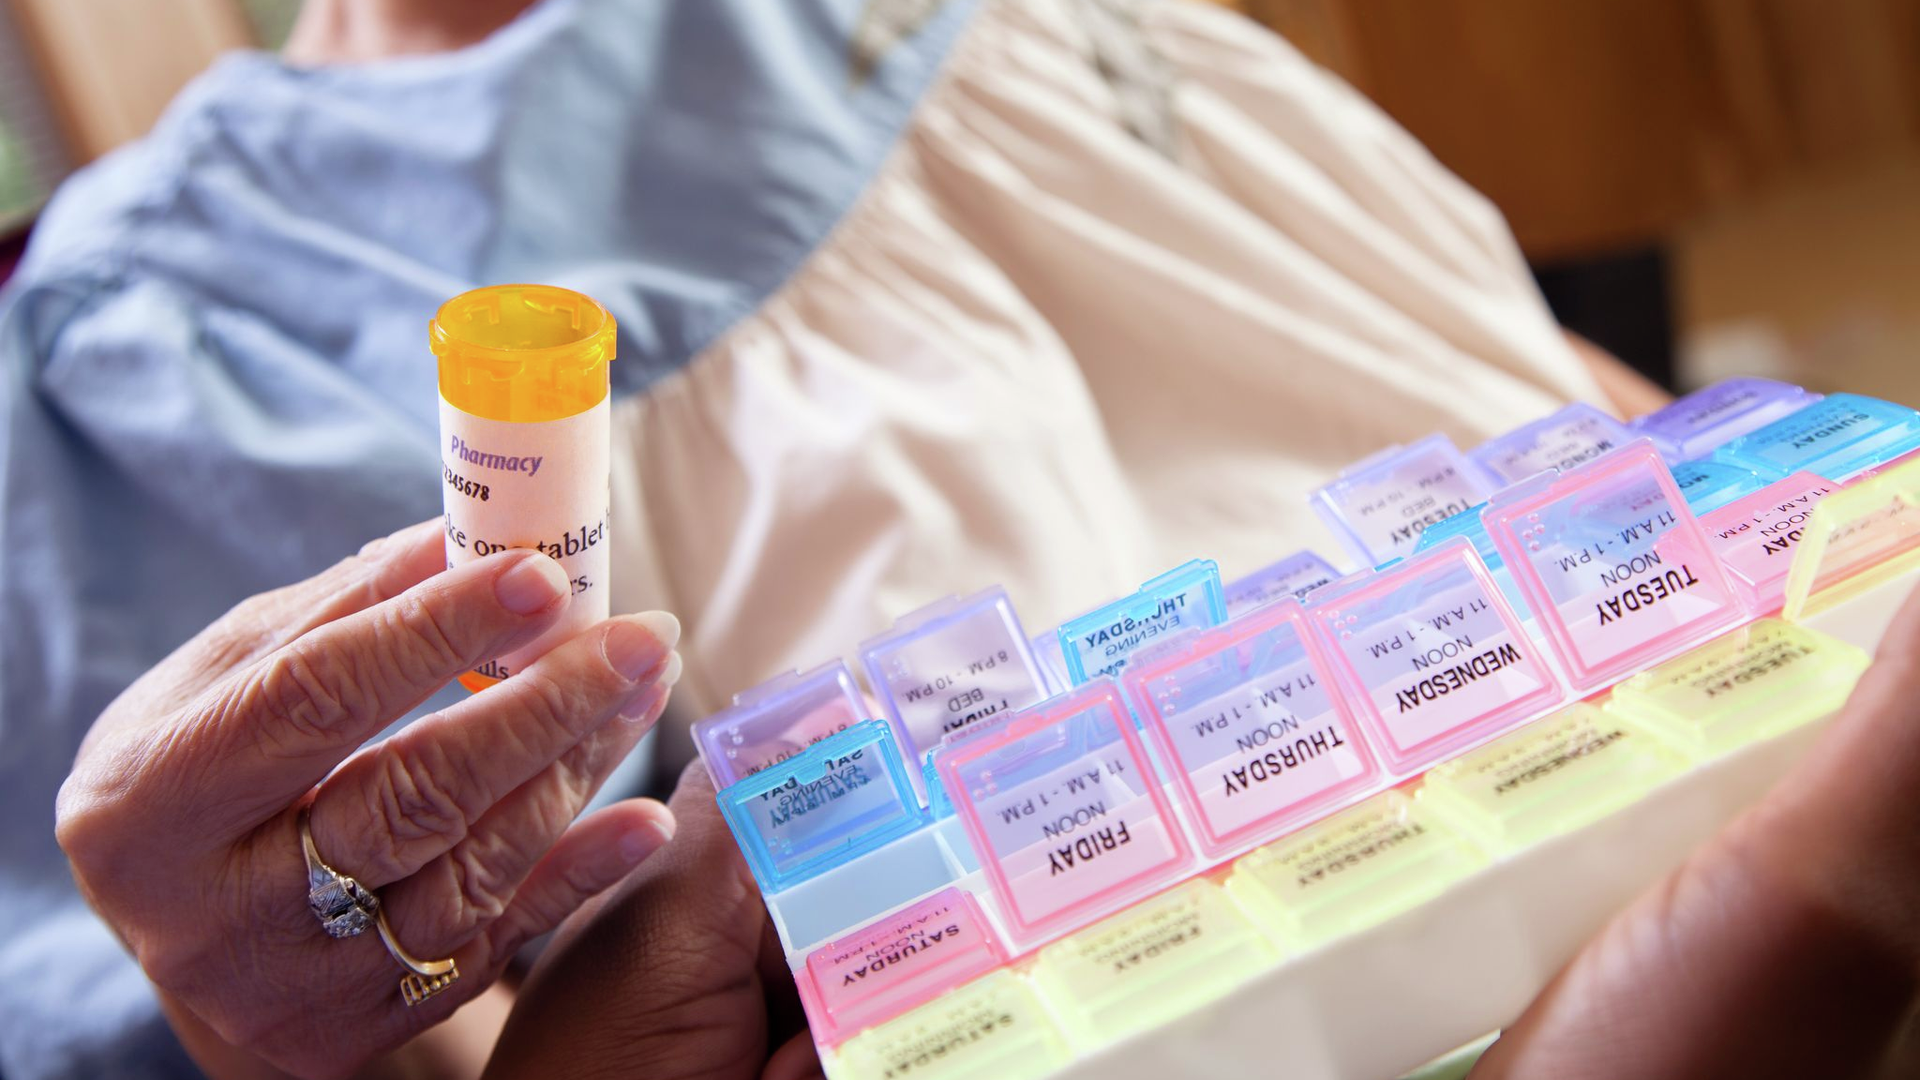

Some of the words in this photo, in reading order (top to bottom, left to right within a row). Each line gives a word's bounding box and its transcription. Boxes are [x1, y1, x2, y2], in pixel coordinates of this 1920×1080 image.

[1792, 413, 1870, 450] SUNDAY
[451, 434, 543, 477] Pharmacy
[1812, 487, 1830, 497] 11
[1657, 510, 1677, 527] 11
[536, 520, 603, 560] tablet
[1594, 543, 1605, 556] 1
[1761, 526, 1805, 556] DAY
[1600, 550, 1663, 588] NOON
[569, 575, 593, 597] rs.
[1596, 564, 1699, 626] TUESDAY
[1469, 598, 1489, 614] 11
[1406, 630, 1417, 642] 1
[1411, 634, 1474, 672] NOON
[935, 675, 954, 690] 10
[1297, 673, 1316, 690] 11
[1395, 643, 1523, 714] WEDNESDAY
[947, 687, 985, 713] BED
[1232, 707, 1243, 720] 1
[1236, 715, 1300, 754] NOON
[1105, 758, 1126, 776] 11
[1222, 726, 1345, 797] THURSDAY
[1038, 793, 1050, 807] 1
[1042, 800, 1107, 841] NOON
[1048, 820, 1132, 876] FRIDAY
[842, 924, 960, 988] SATURDAY
[865, 930, 926, 962] NOON
